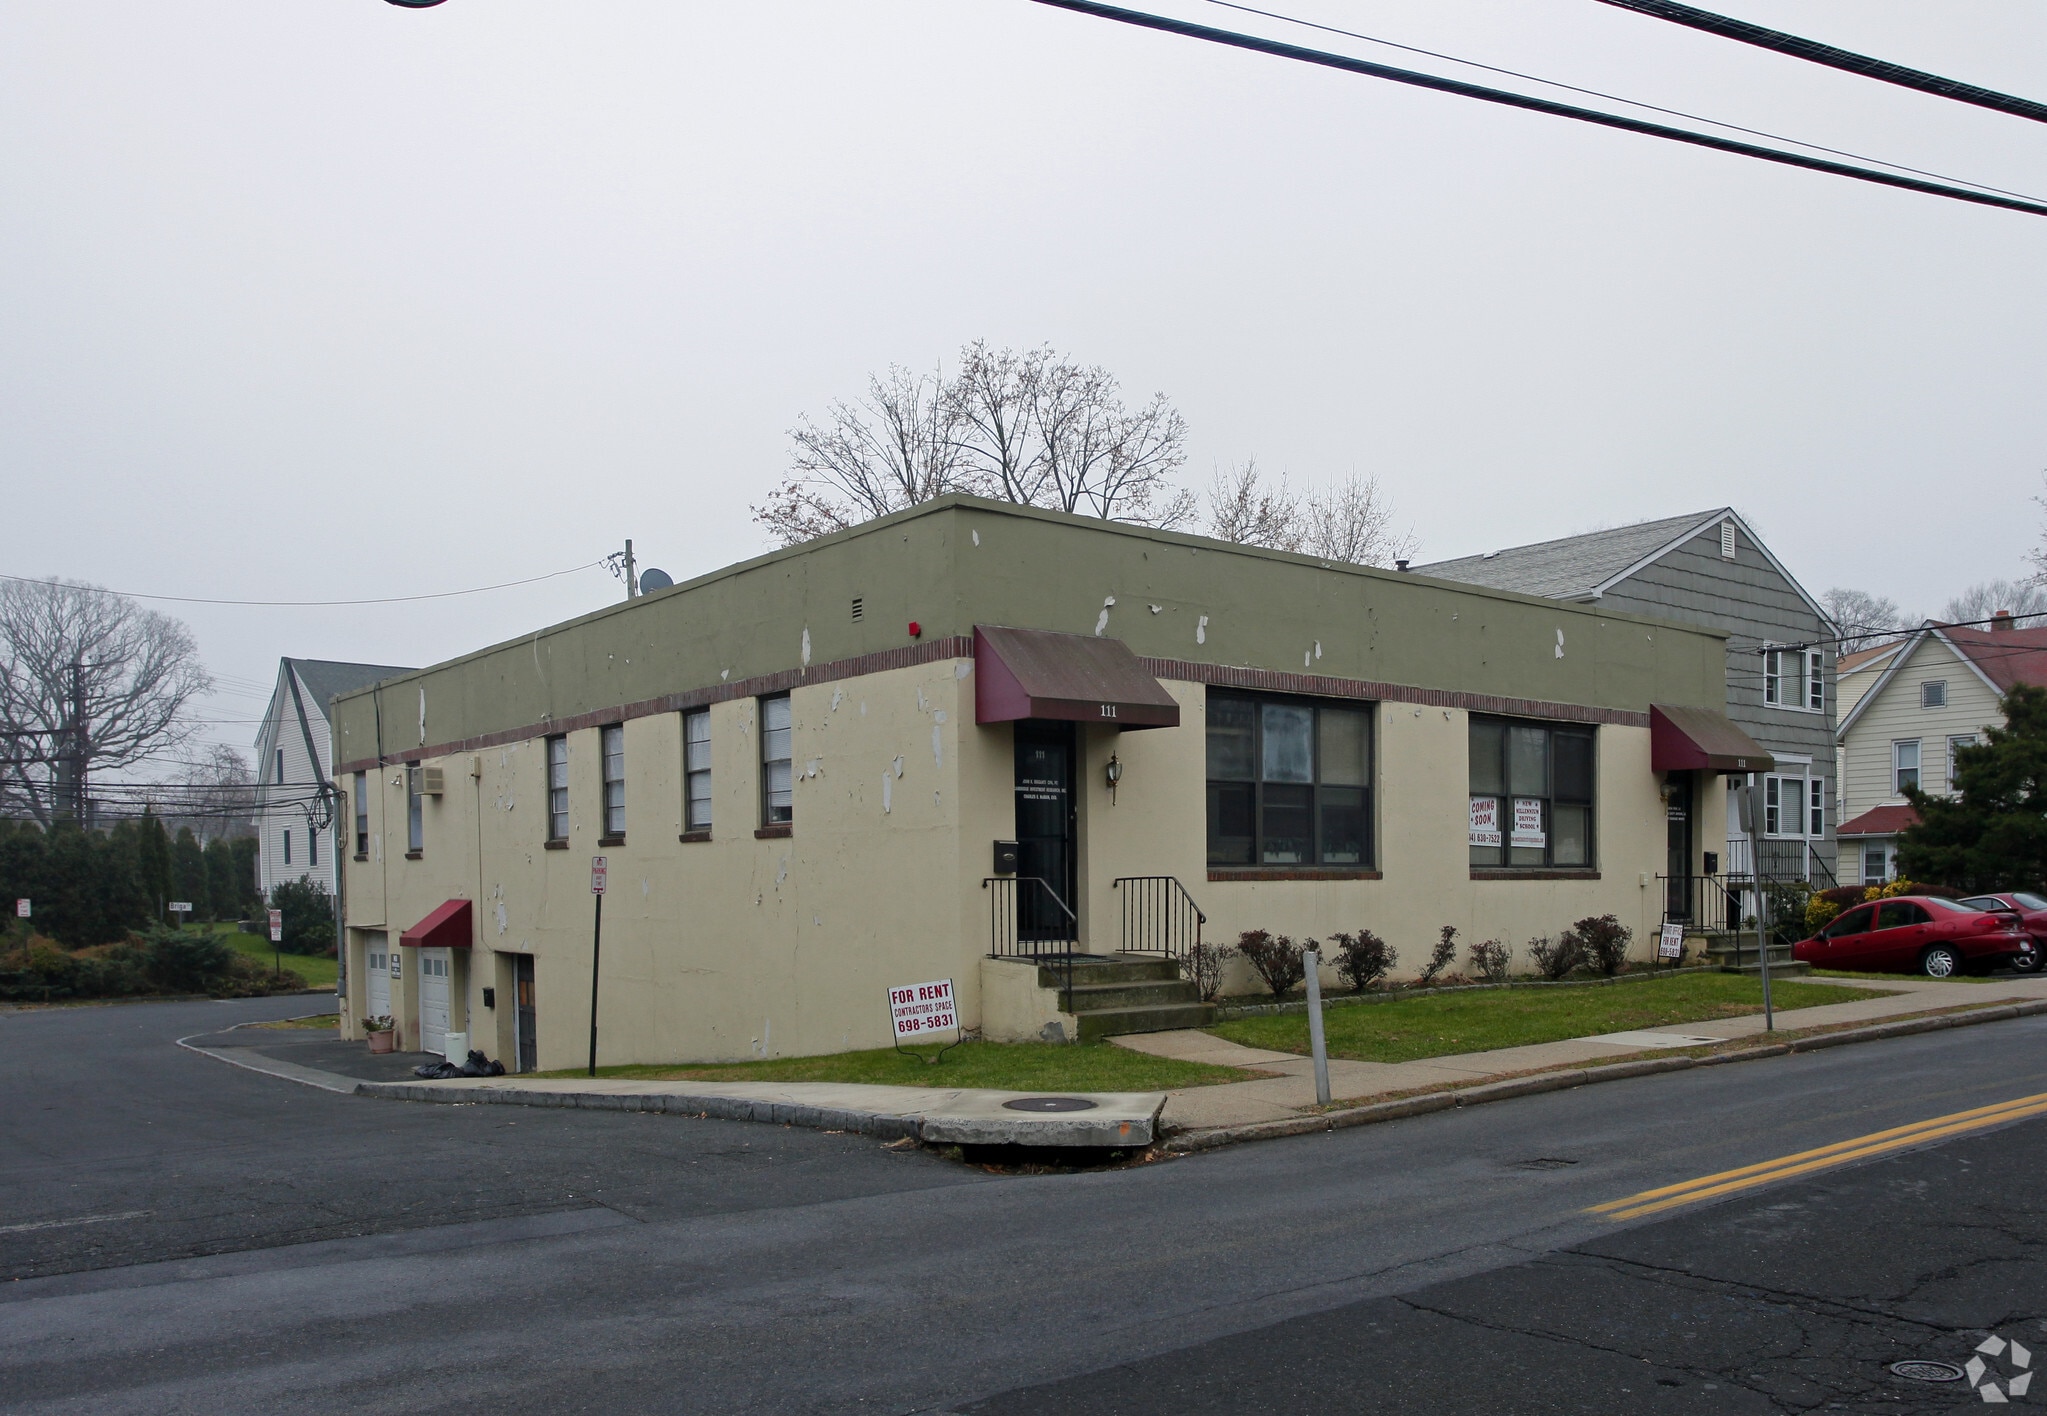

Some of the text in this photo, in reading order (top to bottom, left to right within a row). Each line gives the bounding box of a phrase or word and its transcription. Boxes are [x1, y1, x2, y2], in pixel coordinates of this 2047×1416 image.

[1100, 704, 1116, 718] 111
[1471, 800, 1495, 814] COMING
[1474, 812, 1492, 826] SOON
[1670, 937, 1679, 947] RENT
[892, 983, 949, 1005] FOR RENT
[894, 1000, 953, 1018] CONTRACTORS SPACE
[898, 1013, 954, 1033] 698-5831
